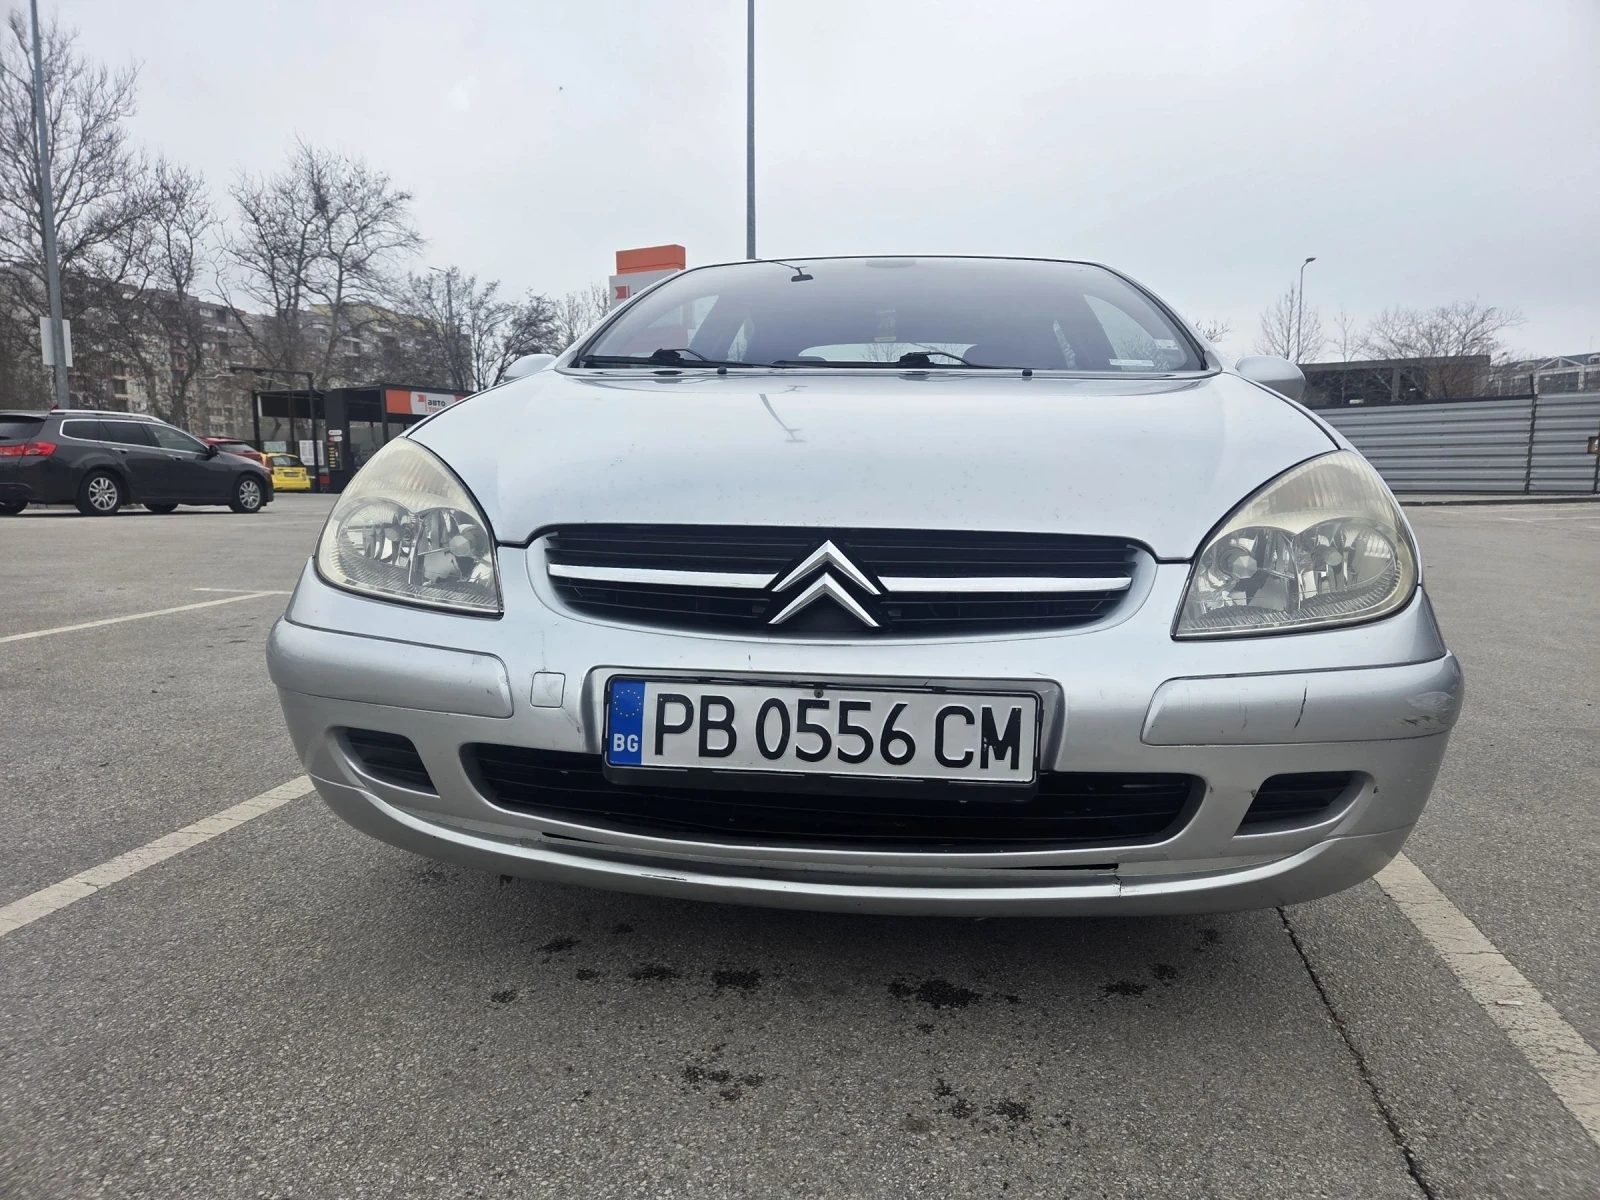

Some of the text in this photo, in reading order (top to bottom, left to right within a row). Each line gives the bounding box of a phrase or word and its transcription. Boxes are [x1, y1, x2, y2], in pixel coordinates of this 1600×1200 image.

[427, 399, 446, 407] авто
[654, 693, 1020, 770] PB 0556 CM
[613, 733, 639, 753] BG
